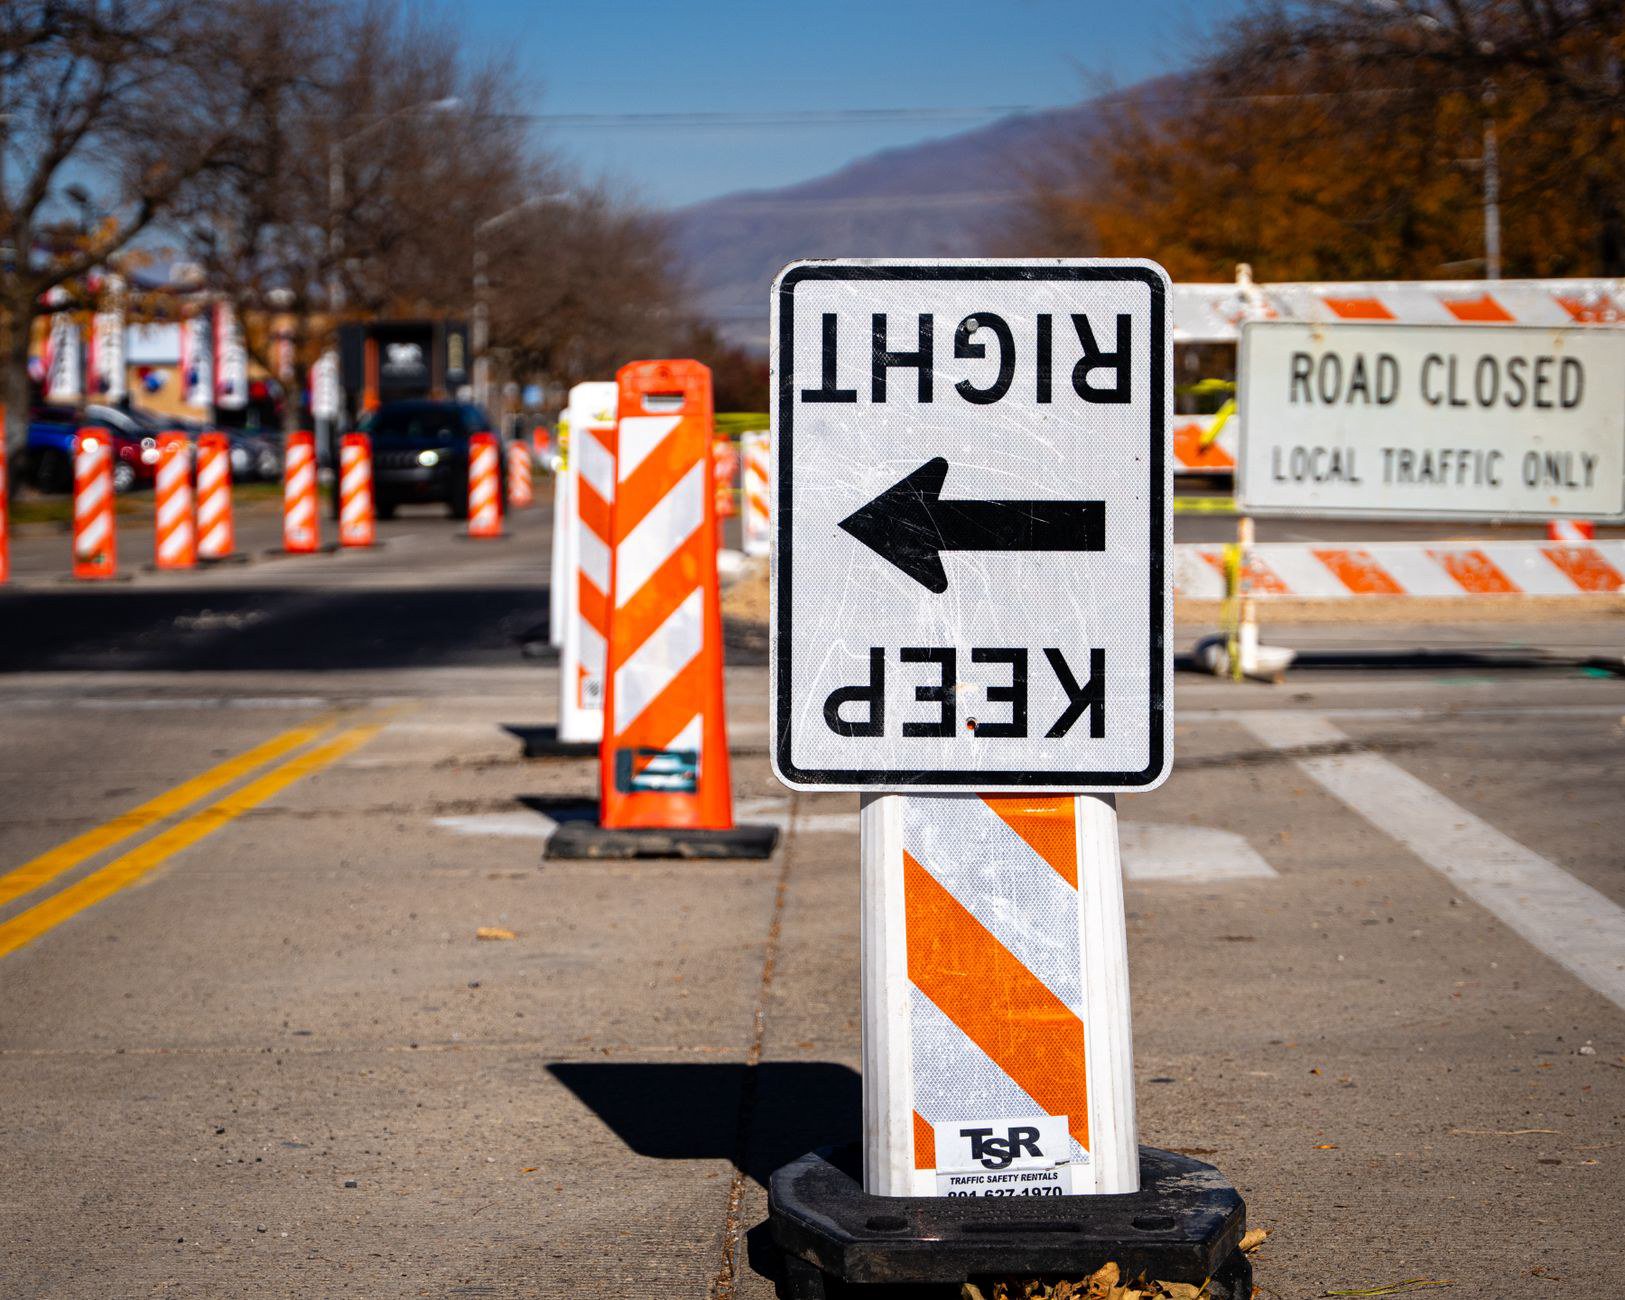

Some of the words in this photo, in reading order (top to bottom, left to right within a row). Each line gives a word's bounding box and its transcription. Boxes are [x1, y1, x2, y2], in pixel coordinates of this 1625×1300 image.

[801, 312, 1132, 405] RIGHT
[1289, 351, 1400, 408] ROAD
[1421, 353, 1586, 411] CLOSED
[1272, 446, 1360, 483] LOCAL
[1381, 447, 1504, 487] TRAFFIC
[1523, 451, 1598, 489] ONLY
[823, 646, 1106, 739] KEEP
[960, 1126, 1044, 1170] TSR
[950, 1176, 985, 1185] TRAFFIC
[986, 1174, 1018, 1183] SAFETY
[1021, 1172, 1058, 1181] RENTALS
